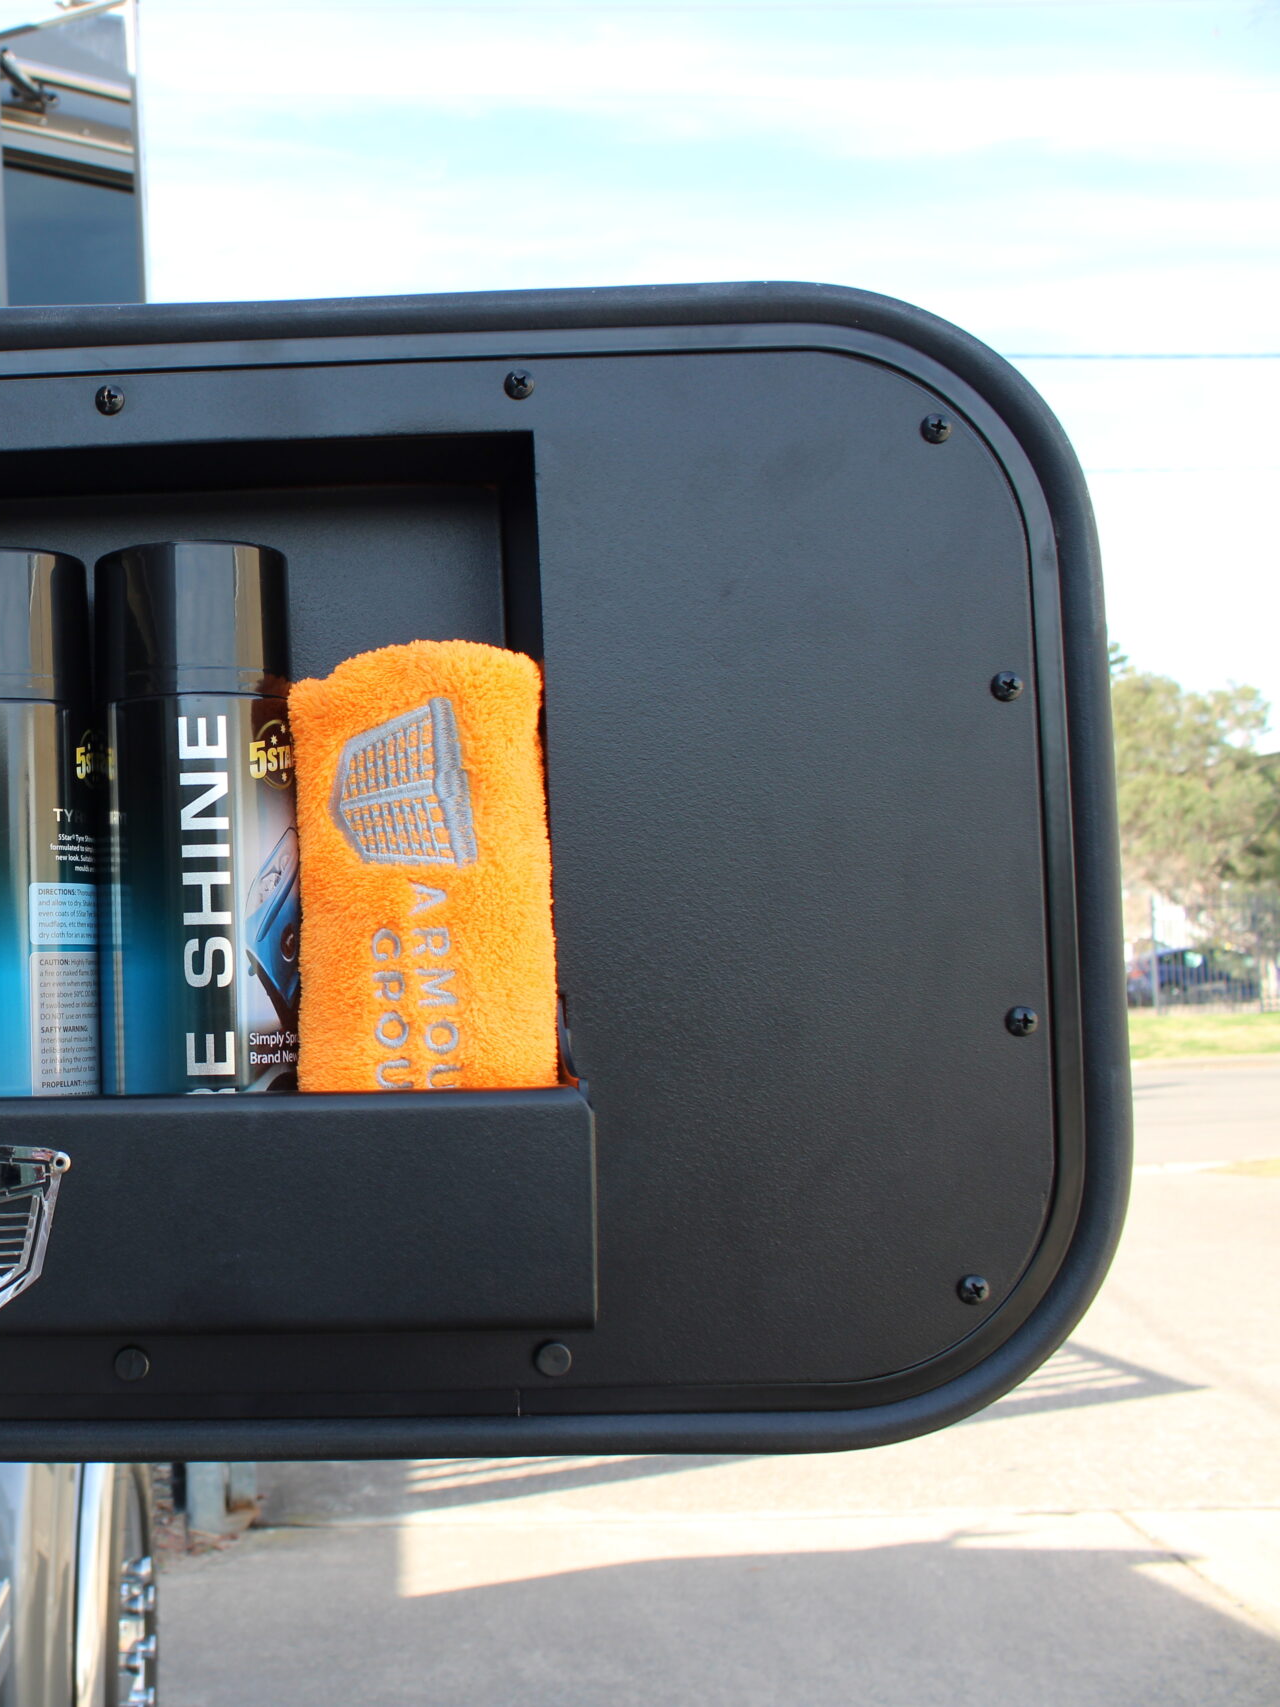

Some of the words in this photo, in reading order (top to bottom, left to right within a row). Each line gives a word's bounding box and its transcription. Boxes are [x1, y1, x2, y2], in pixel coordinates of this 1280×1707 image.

[68, 854, 80, 862] look.
[177, 715, 234, 988] SHINE
[250, 1031, 284, 1047] Simply
[250, 1050, 280, 1064] Brand
